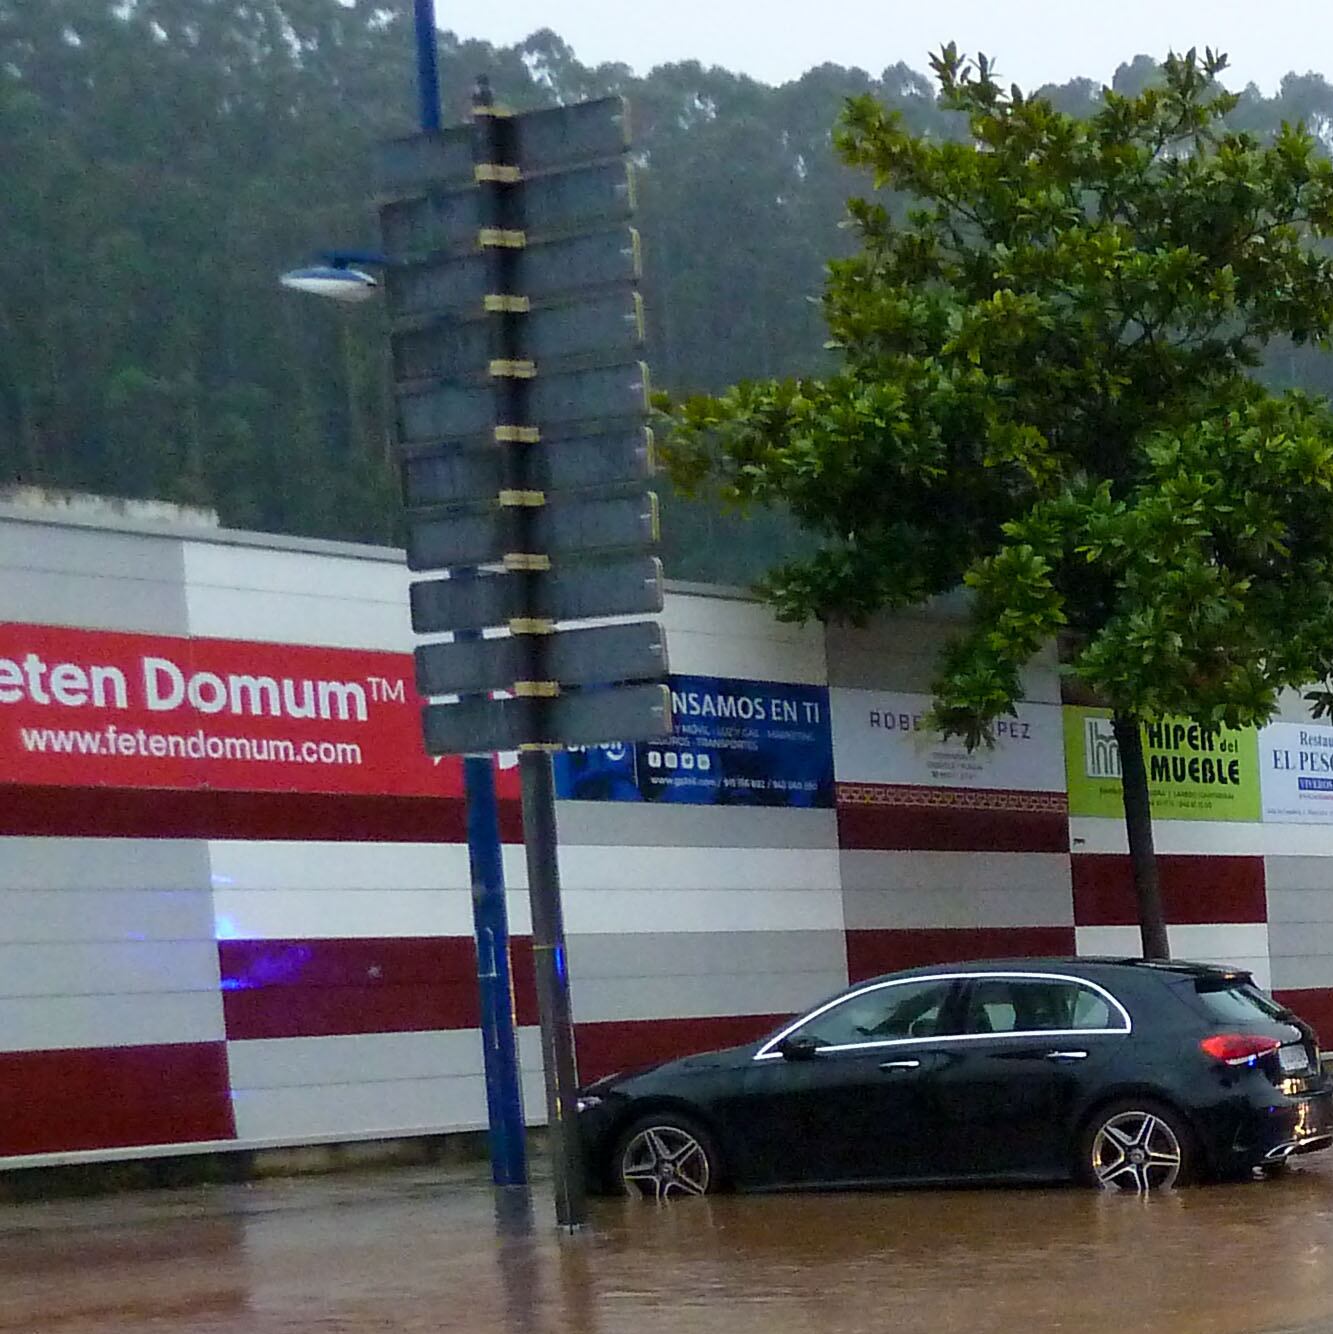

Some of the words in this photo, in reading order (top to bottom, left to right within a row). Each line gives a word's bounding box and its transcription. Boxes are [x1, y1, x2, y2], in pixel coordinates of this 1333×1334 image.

[142, 656, 368, 722] Domum
[772, 699, 798, 722] EN
[803, 702, 820, 724] TI
[991, 719, 1031, 740] PEZ
[21, 725, 364, 765] www.fetendomum.com
[1150, 755, 1241, 786] MUEBLE
[1273, 749, 1296, 771] EL
